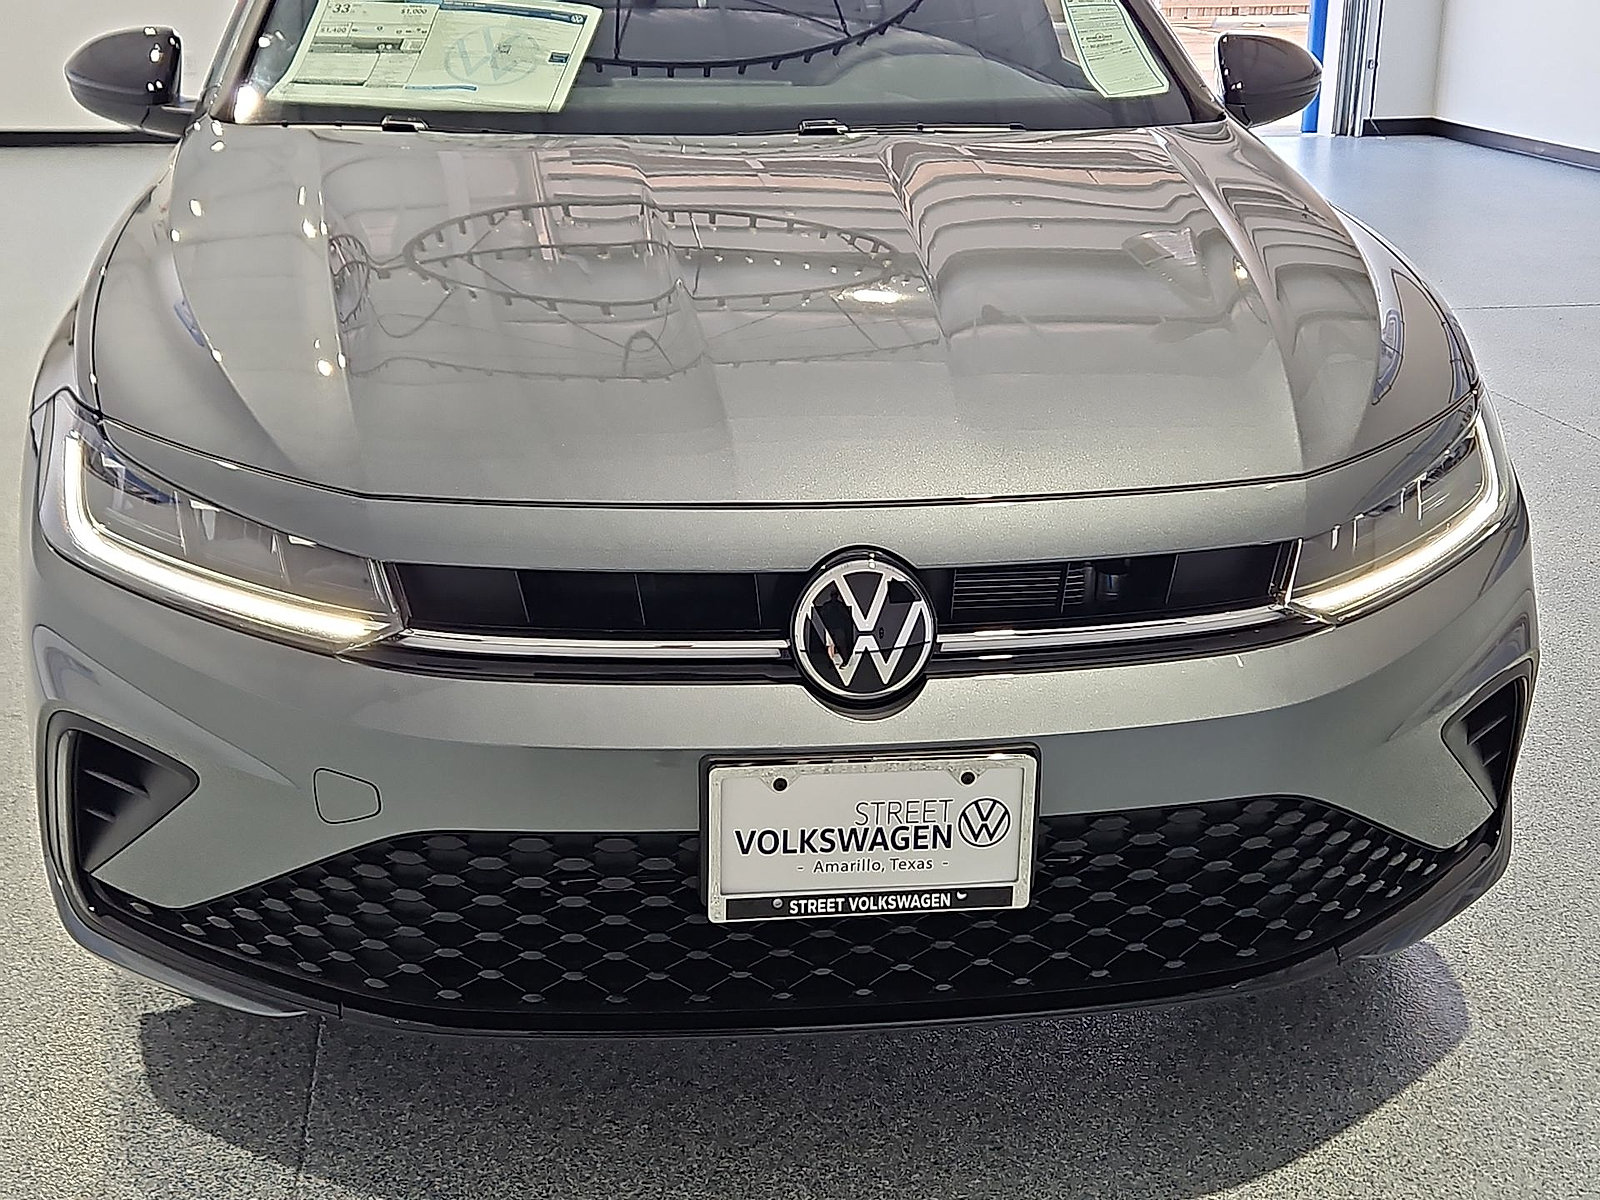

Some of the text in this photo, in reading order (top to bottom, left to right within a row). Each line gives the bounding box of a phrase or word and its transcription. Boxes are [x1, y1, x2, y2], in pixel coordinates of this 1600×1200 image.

[332, 4, 350, 13] 33
[854, 799, 953, 825] STREET
[734, 824, 953, 855] VOLKSWAGEN
[813, 856, 933, 873] Amarillo, Texas
[789, 892, 950, 914] STREET VOLKSWAGEN
